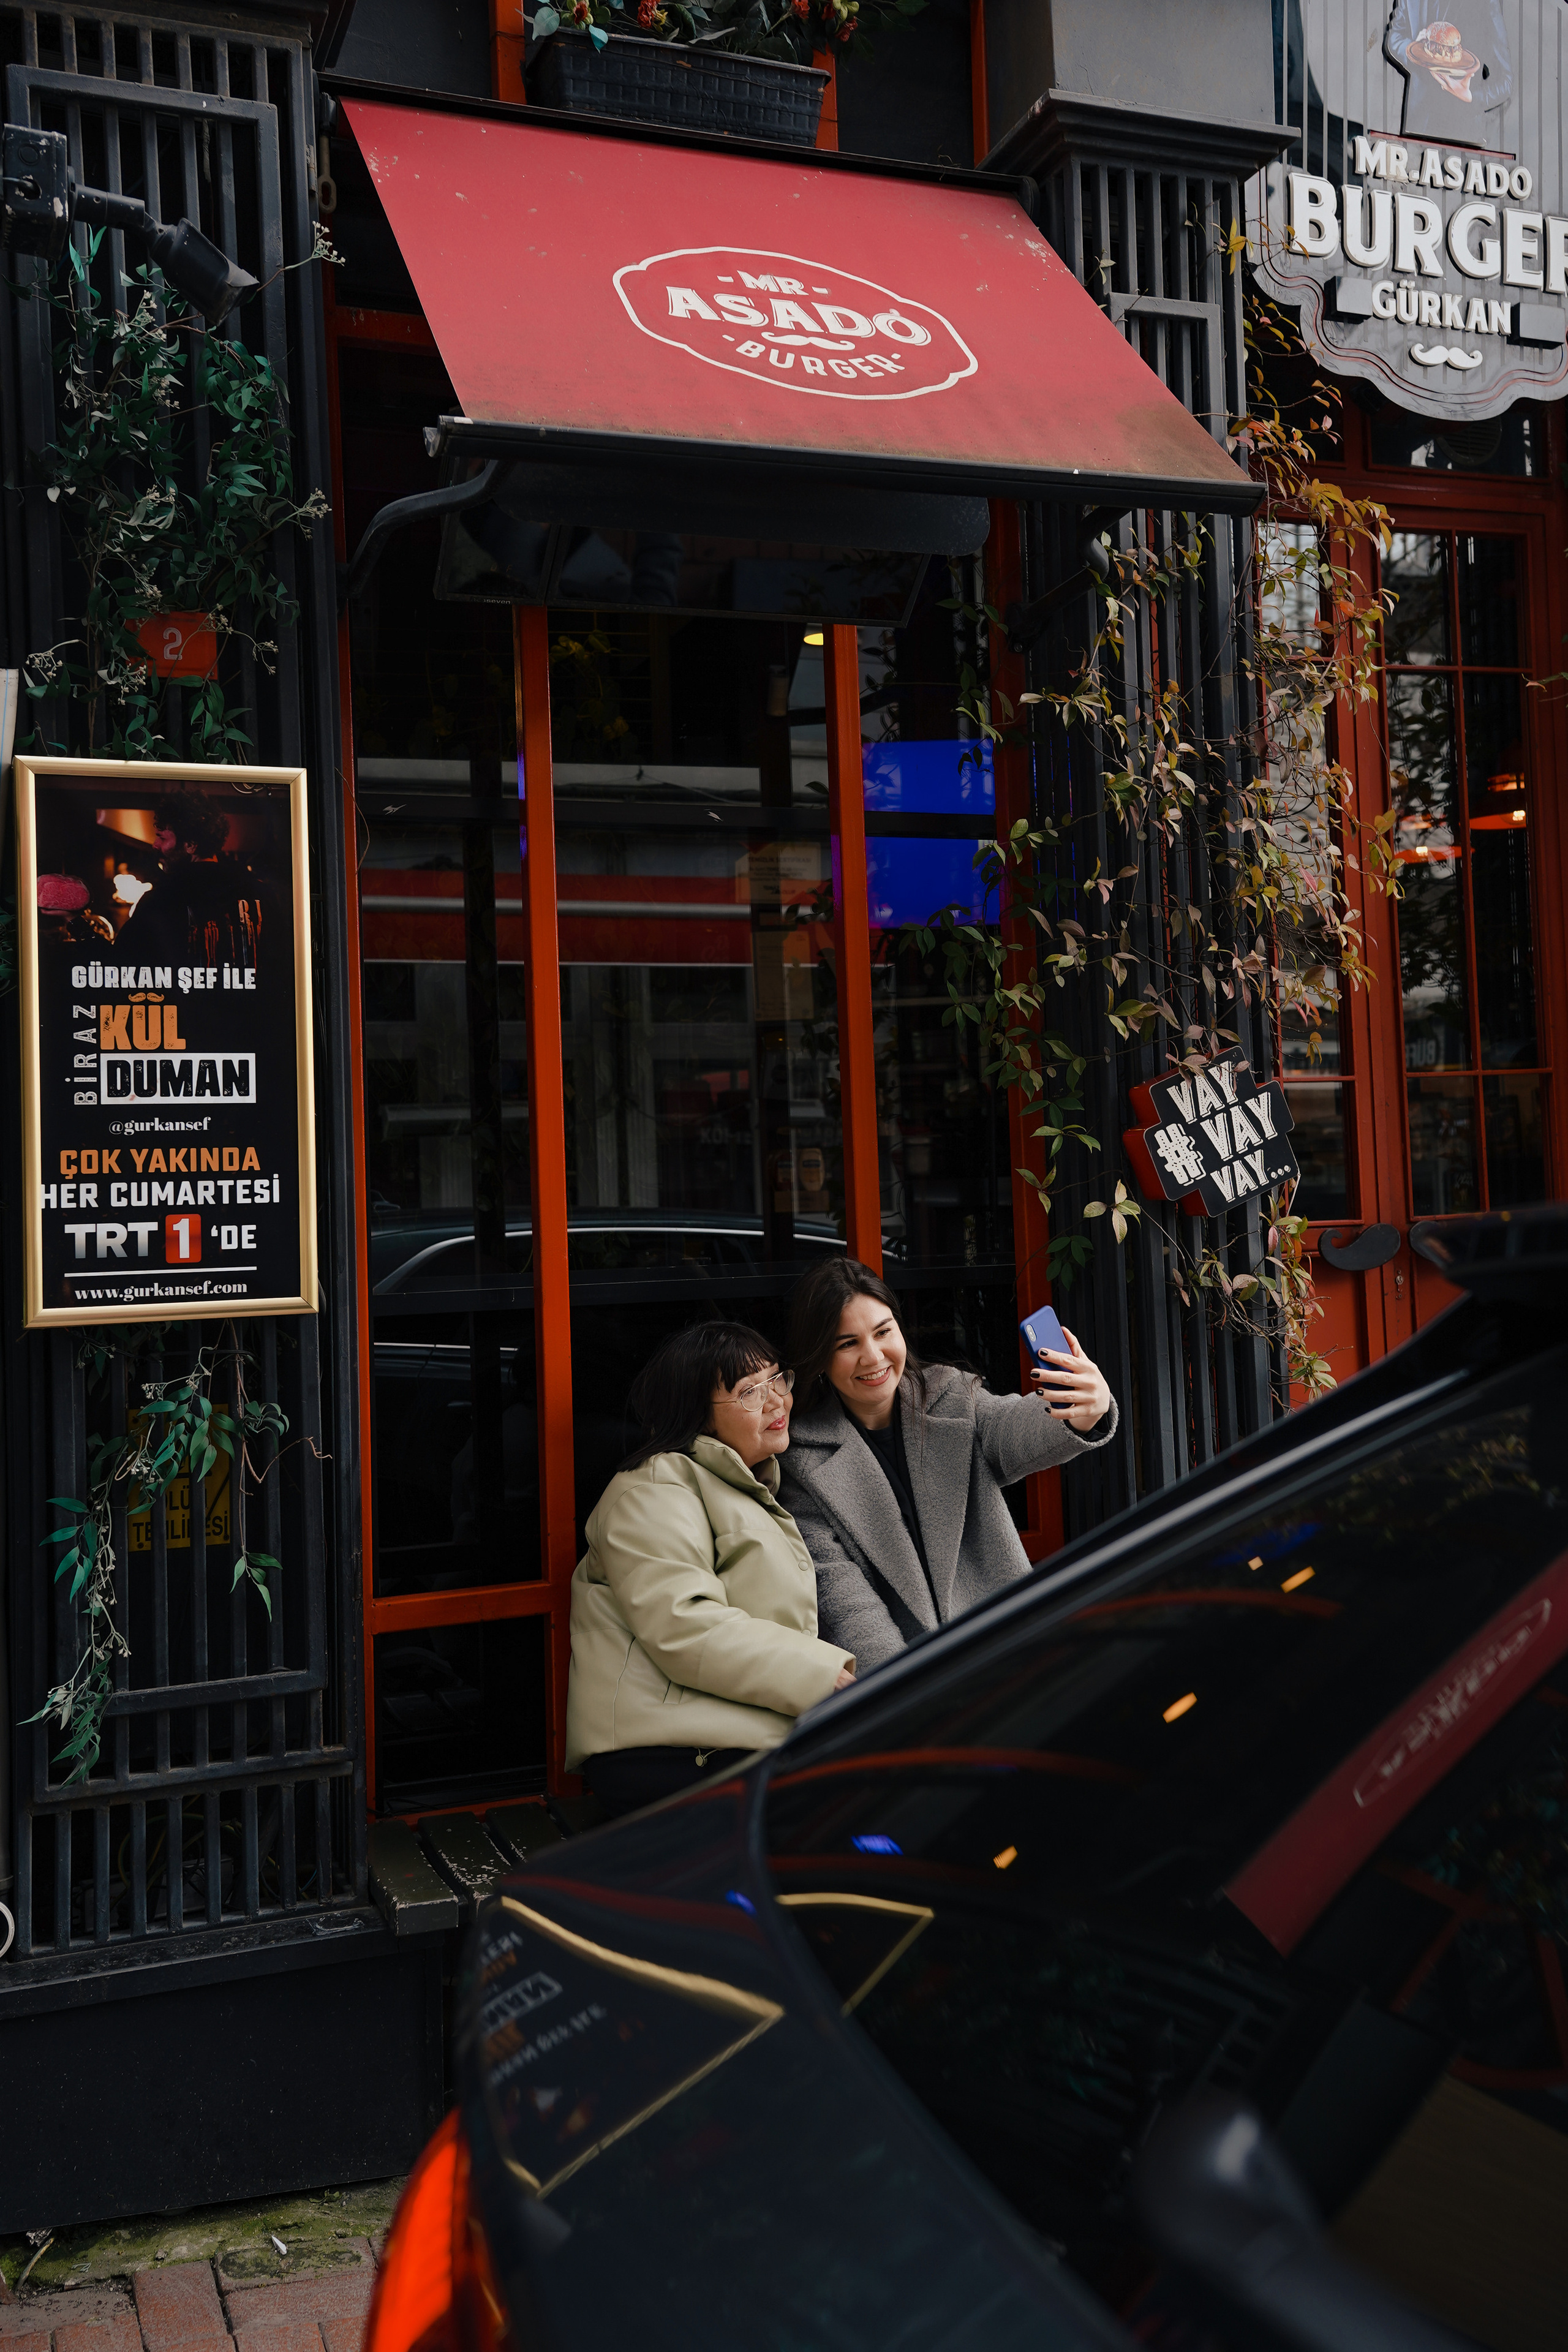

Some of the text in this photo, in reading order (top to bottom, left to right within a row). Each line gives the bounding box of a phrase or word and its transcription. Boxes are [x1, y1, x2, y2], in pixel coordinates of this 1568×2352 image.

[1371, 279, 1511, 336] GÜRKAN
[736, 340, 905, 379] BURGER
[163, 627, 183, 660] 2
[72, 962, 256, 993] GÜRKAN ŞEF İLE
[107, 1060, 250, 1098] DUMAN
[1166, 1061, 1238, 1125] VAY
[108, 1117, 211, 1136] @gurkansef
[1200, 1091, 1278, 1161] VAY
[60, 1147, 260, 1179] ÇOK YAKINDA
[41, 1174, 280, 1208] HER CUMARTESİ
[64, 1221, 158, 1258] TRT
[173, 1218, 190, 1258] 1
[75, 1281, 247, 1302] www.gurkansef.com
